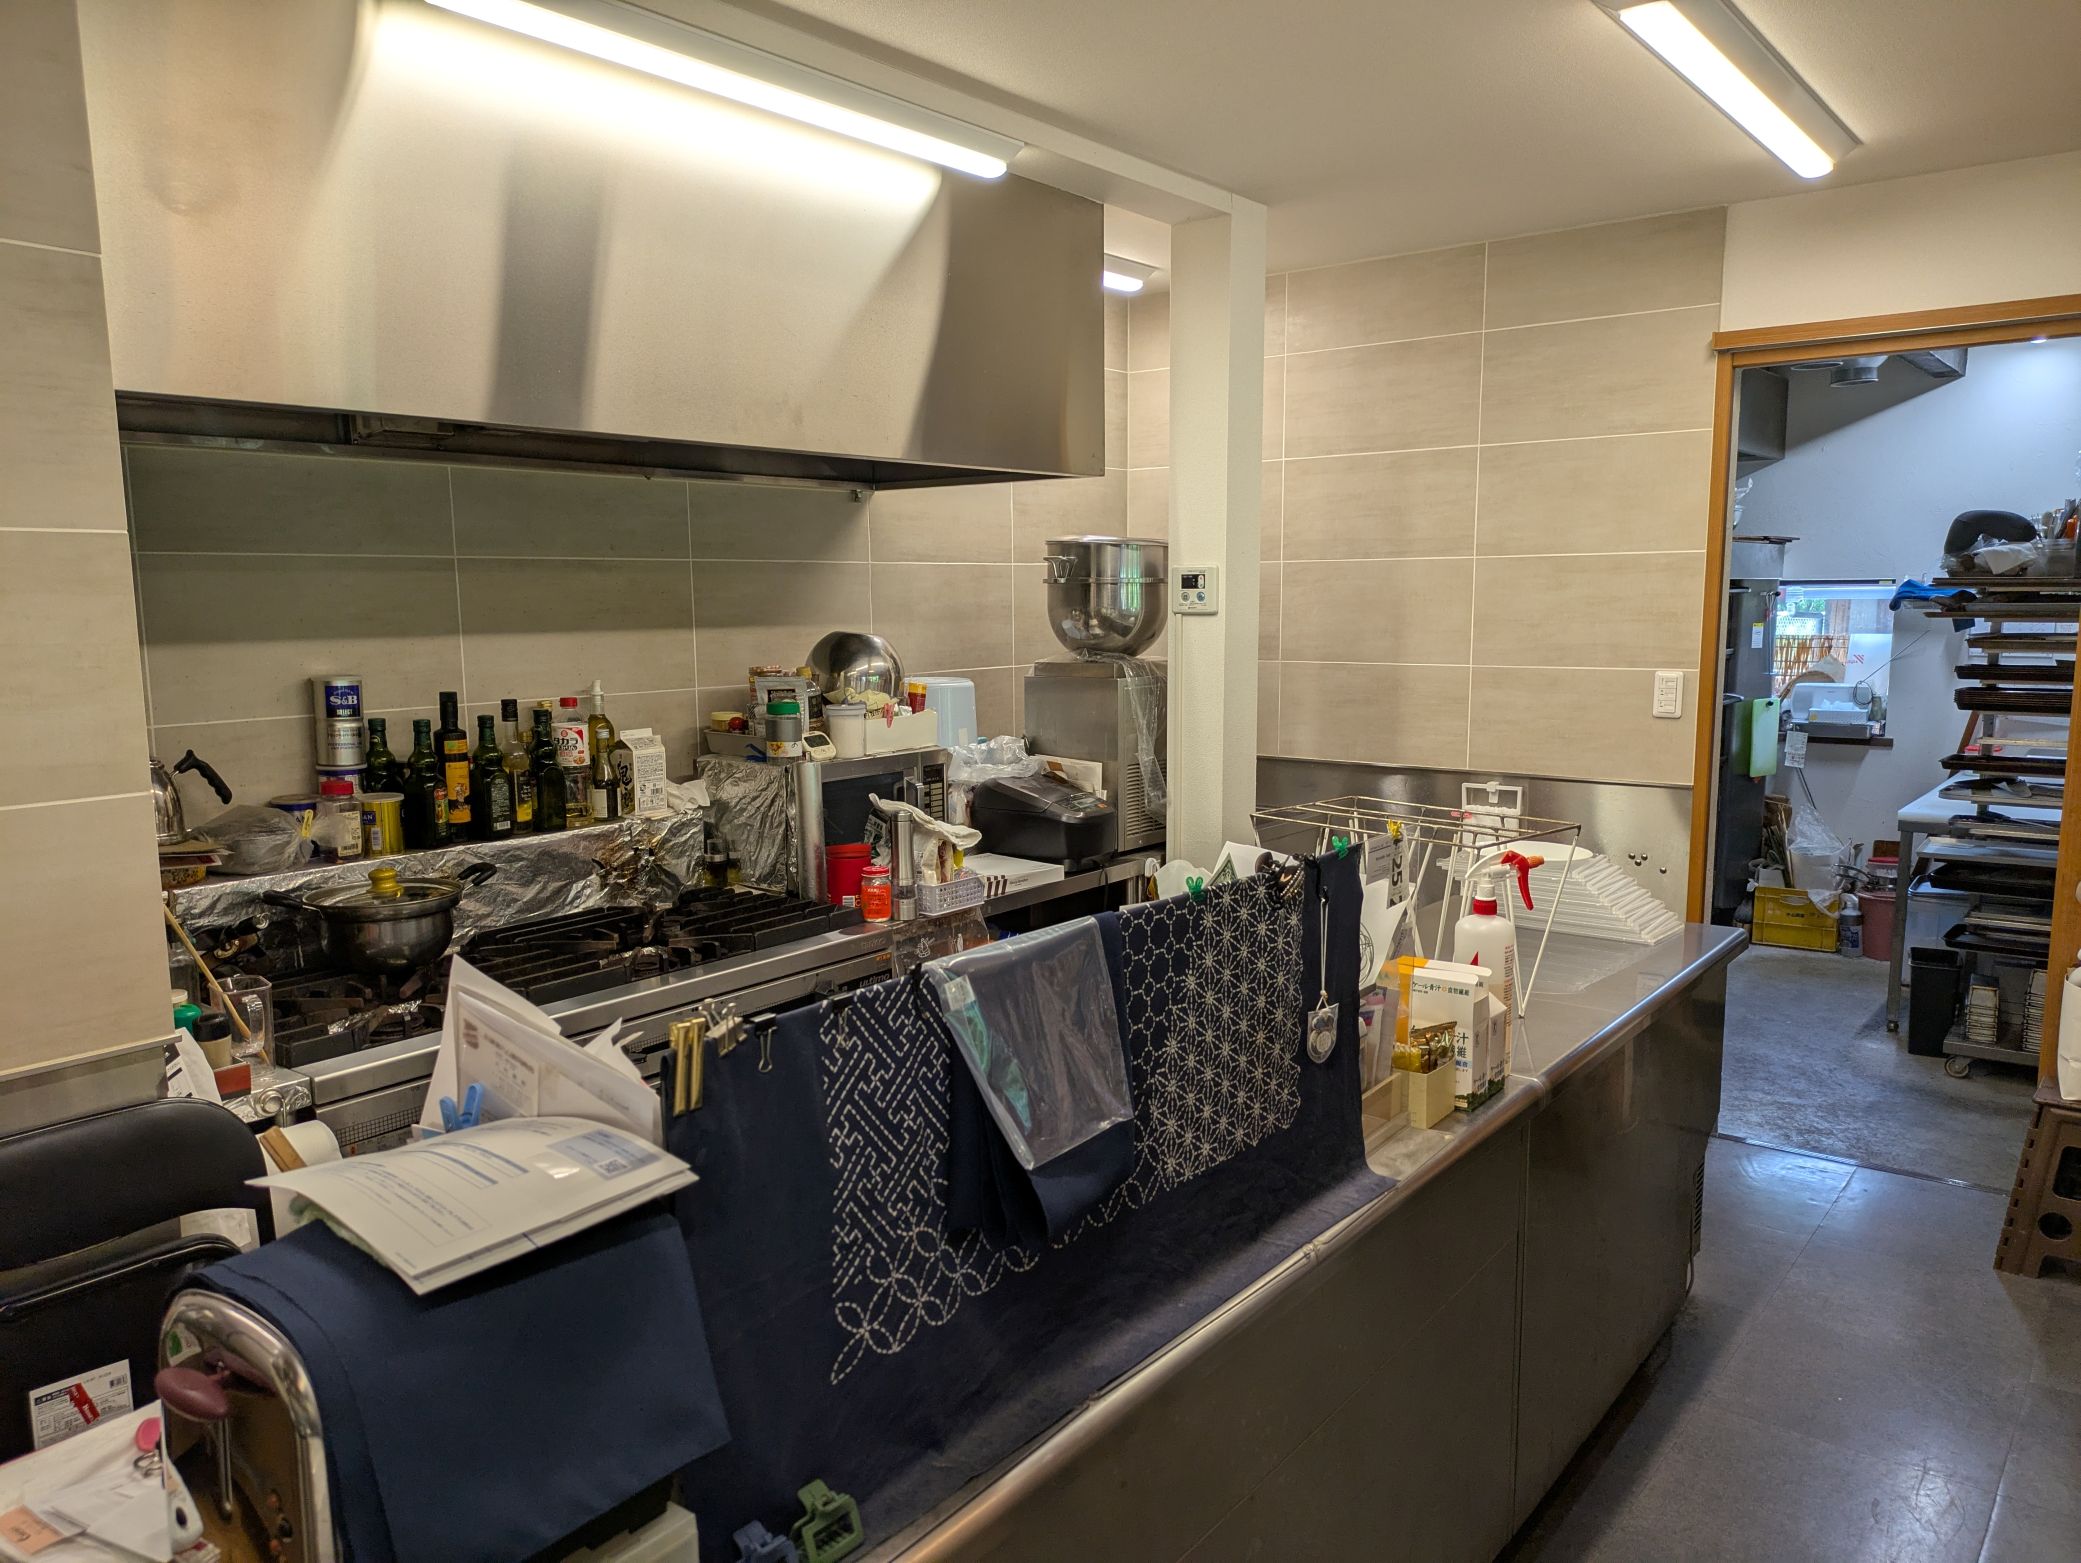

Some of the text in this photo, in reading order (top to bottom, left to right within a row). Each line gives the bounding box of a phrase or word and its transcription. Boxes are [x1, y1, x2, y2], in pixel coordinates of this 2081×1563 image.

[329, 695, 358, 705] S&B
[554, 737, 578, 745] タカラ
